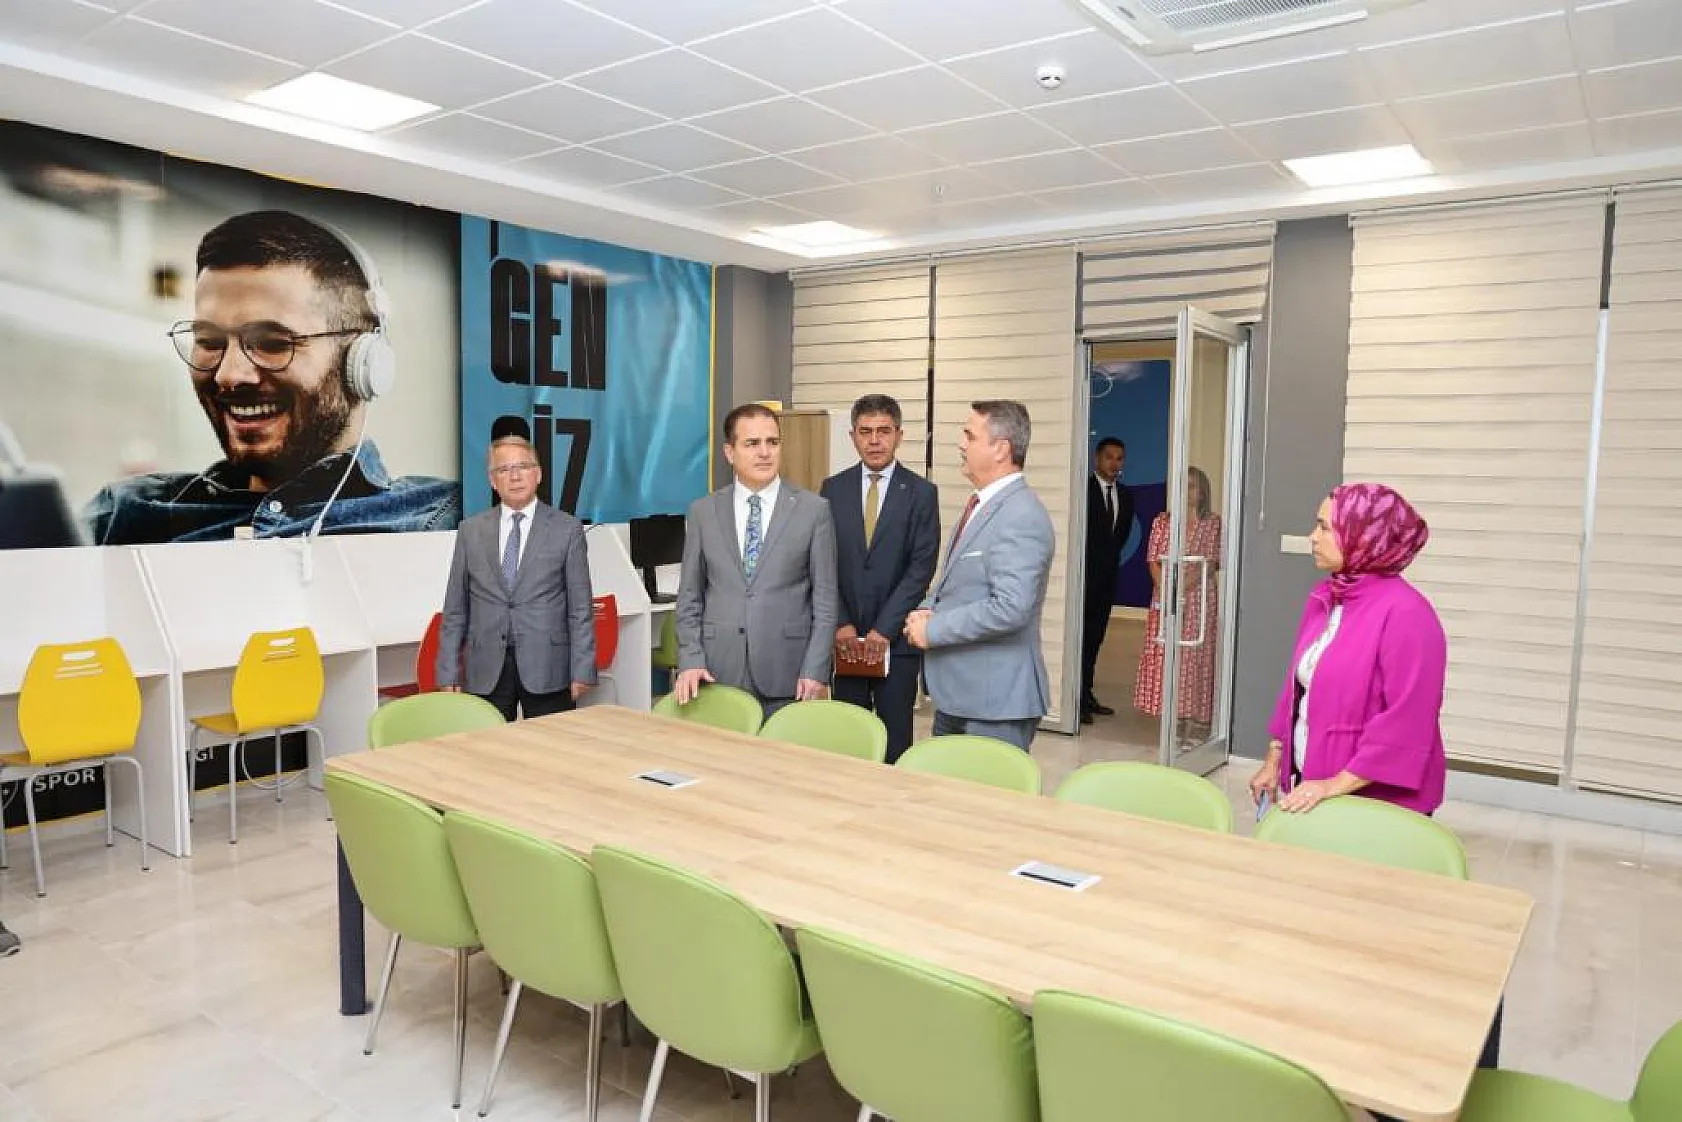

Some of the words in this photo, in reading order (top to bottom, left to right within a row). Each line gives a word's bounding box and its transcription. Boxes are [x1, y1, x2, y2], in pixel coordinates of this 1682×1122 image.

[490, 258, 606, 391] GEN
[490, 403, 592, 525] İZ
[34, 768, 96, 792] SPOR
